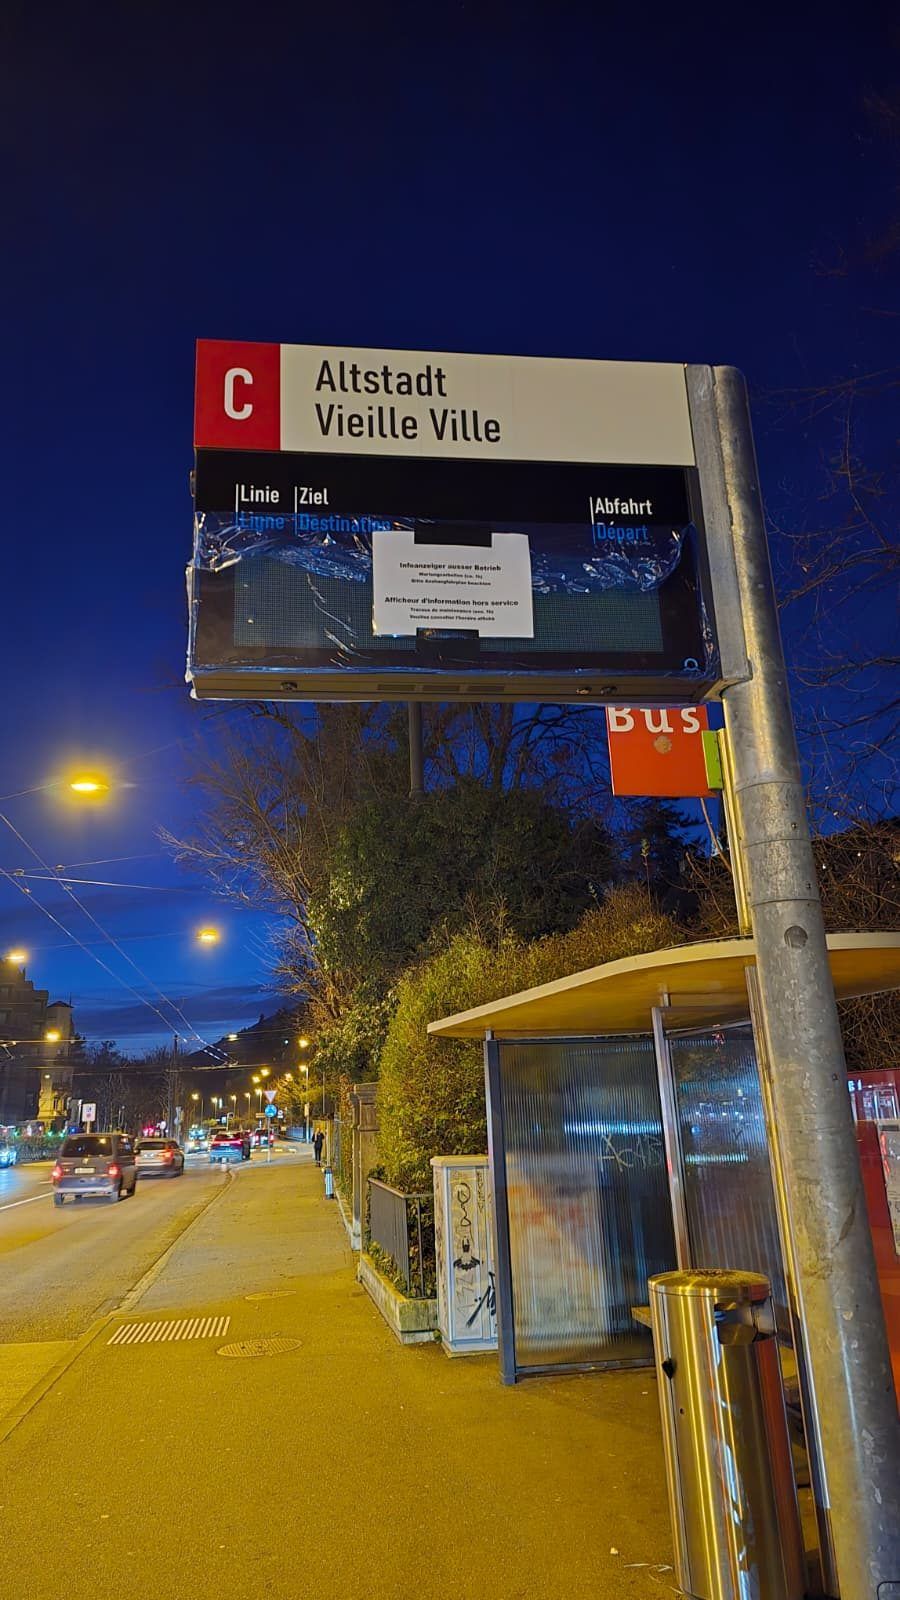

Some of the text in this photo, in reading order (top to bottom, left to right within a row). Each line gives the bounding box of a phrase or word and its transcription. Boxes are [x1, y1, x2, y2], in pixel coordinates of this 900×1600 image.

[314, 359, 448, 397] Altstadt
[223, 367, 254, 421] C
[314, 402, 502, 443] Vieille Ville
[240, 484, 280, 503] Linie
[299, 487, 329, 505] Ziel
[594, 497, 653, 515] Abfahrt
[239, 511, 285, 531] Ligne
[597, 521, 648, 544] Départ
[384, 596, 420, 604] Afficheur
[421, 597, 471, 605] d'information
[607, 707, 700, 734] Bus
